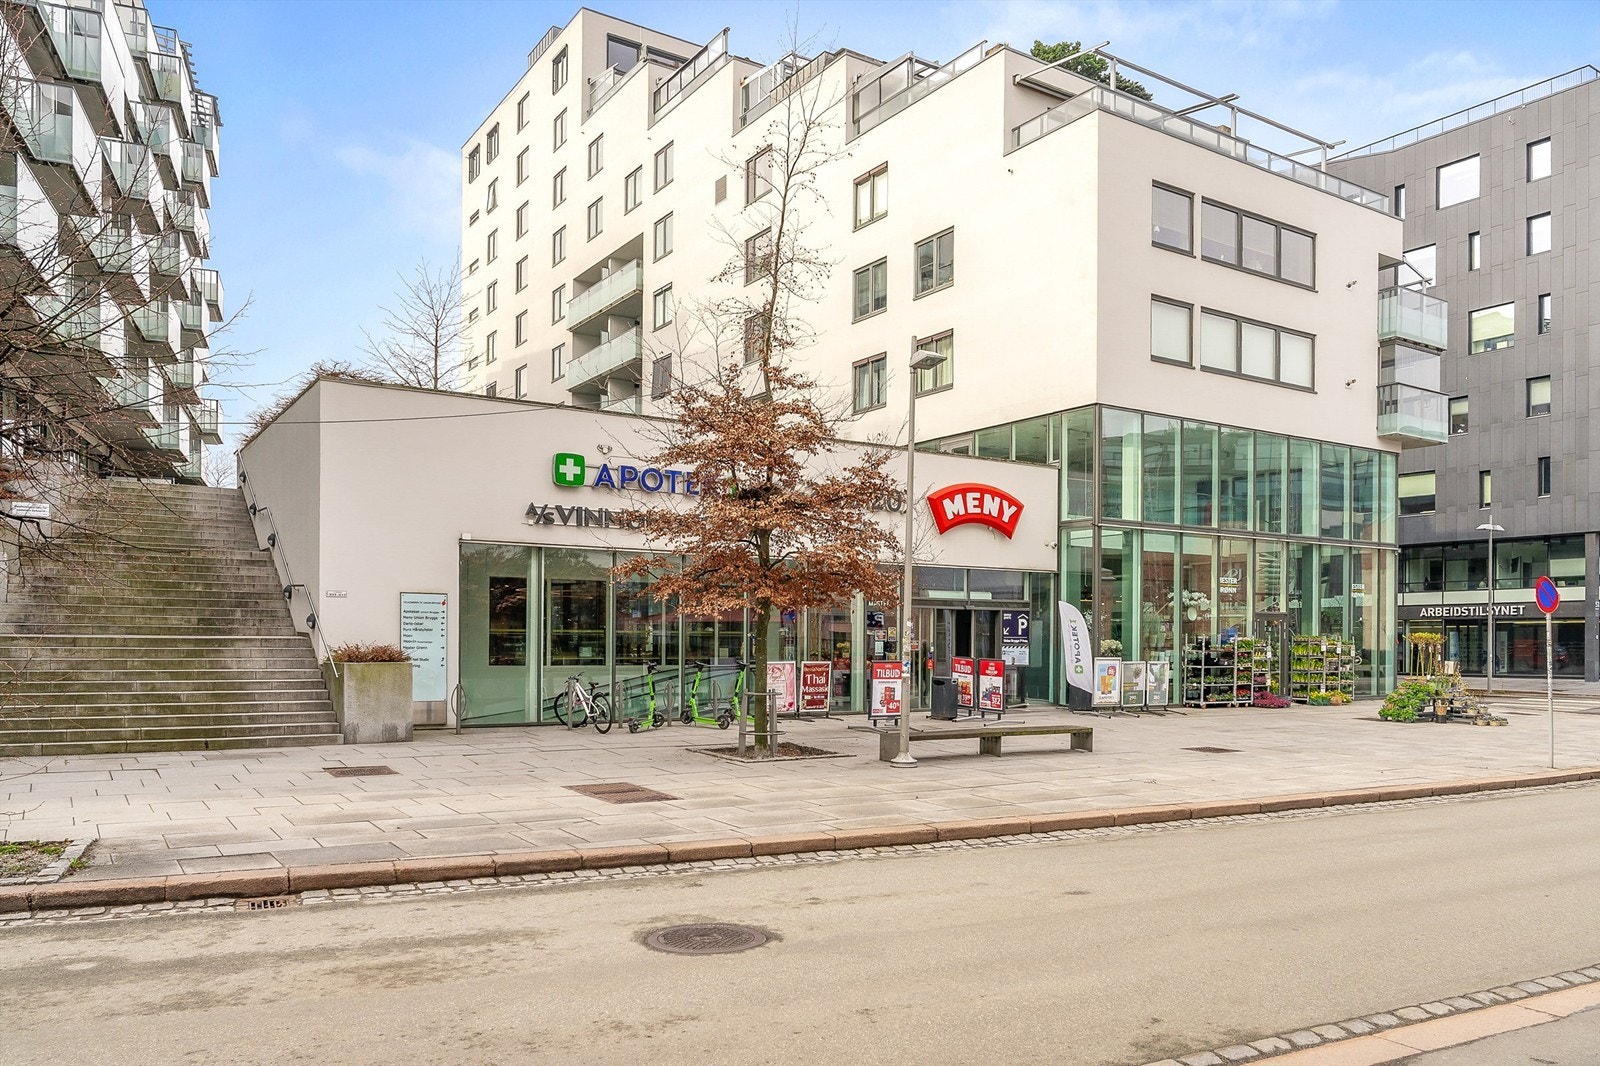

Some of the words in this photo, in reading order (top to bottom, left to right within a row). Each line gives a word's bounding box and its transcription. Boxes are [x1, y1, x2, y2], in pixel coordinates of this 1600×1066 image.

[592, 463, 716, 497] APOTE
[942, 492, 1018, 523] MENY
[1018, 618, 1028, 635] P
[805, 672, 826, 685] Thai
[876, 669, 901, 678] TILBUD
